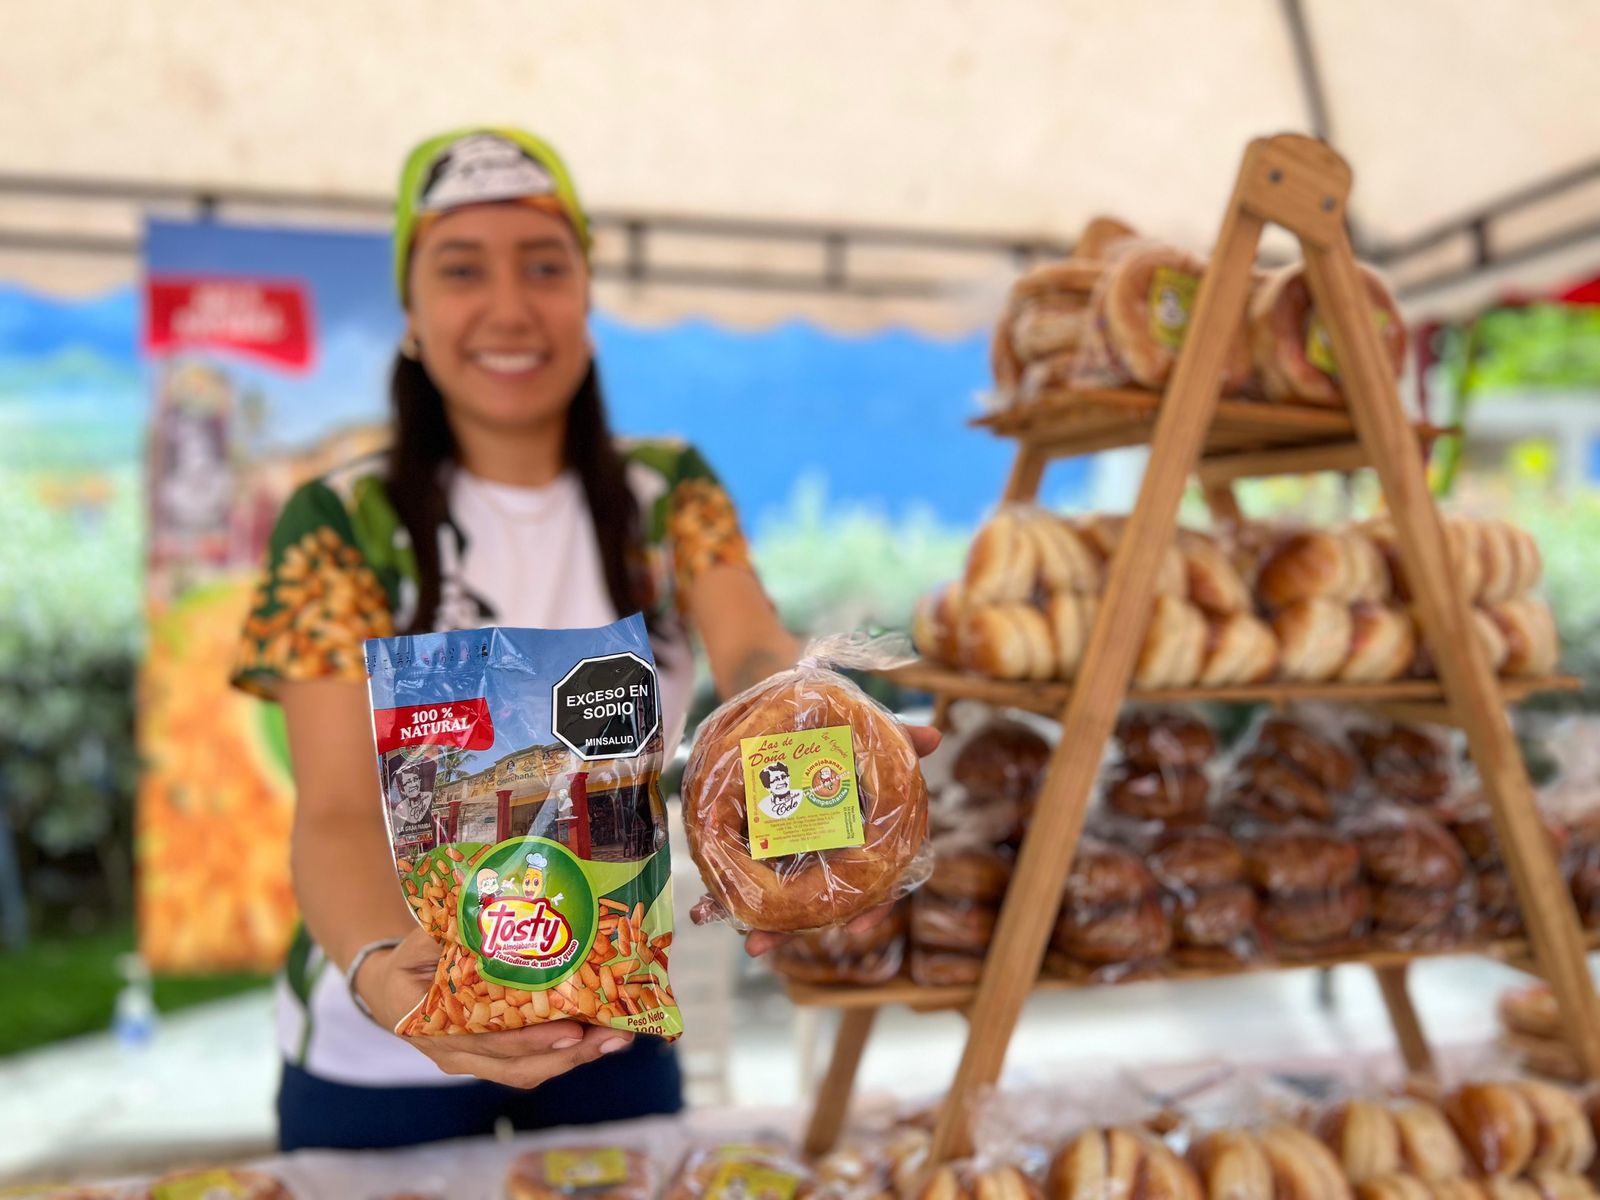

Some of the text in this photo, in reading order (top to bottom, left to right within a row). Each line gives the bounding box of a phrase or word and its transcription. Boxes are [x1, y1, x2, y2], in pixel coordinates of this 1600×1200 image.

[566, 685, 648, 707] EXCESO EN
[411, 707, 453, 724] 100 %
[583, 702, 634, 719] SODIO
[400, 717, 471, 740] NATURAL
[585, 735, 634, 746] MINSALUD
[758, 737, 793, 751] Las de
[748, 750, 787, 767] Doña
[792, 742, 821, 760] Cele
[487, 904, 561, 952] Tosty
[495, 951, 530, 966] Tostaditas
[563, 940, 578, 960] queso
[627, 1010, 665, 1026] Peso Neto
